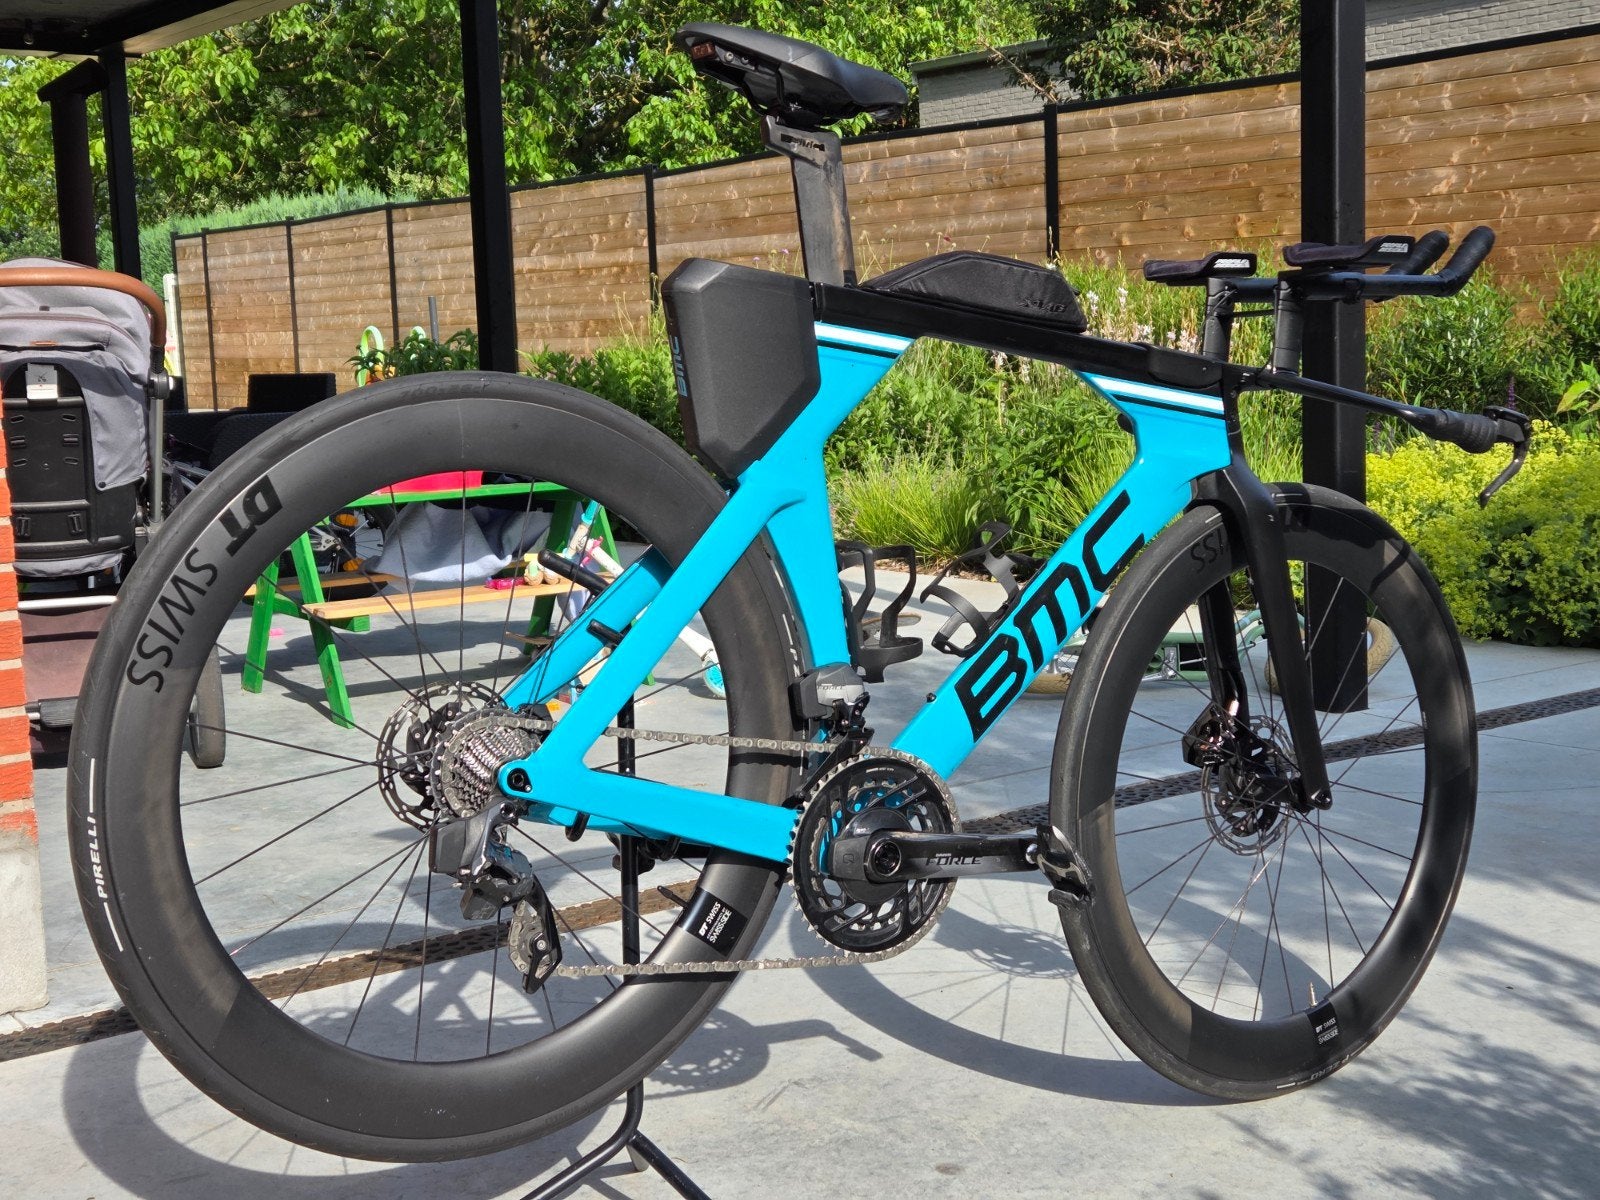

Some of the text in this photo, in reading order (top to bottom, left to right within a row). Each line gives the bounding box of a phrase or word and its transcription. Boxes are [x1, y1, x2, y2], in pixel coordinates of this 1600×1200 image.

[669, 335, 688, 397] BMC
[126, 474, 283, 694] DT SWISS
[954, 489, 1145, 743] BMC
[87, 816, 109, 899] PIRELLI
[925, 856, 982, 866] FORCE
[699, 902, 720, 936] DT SWISS
